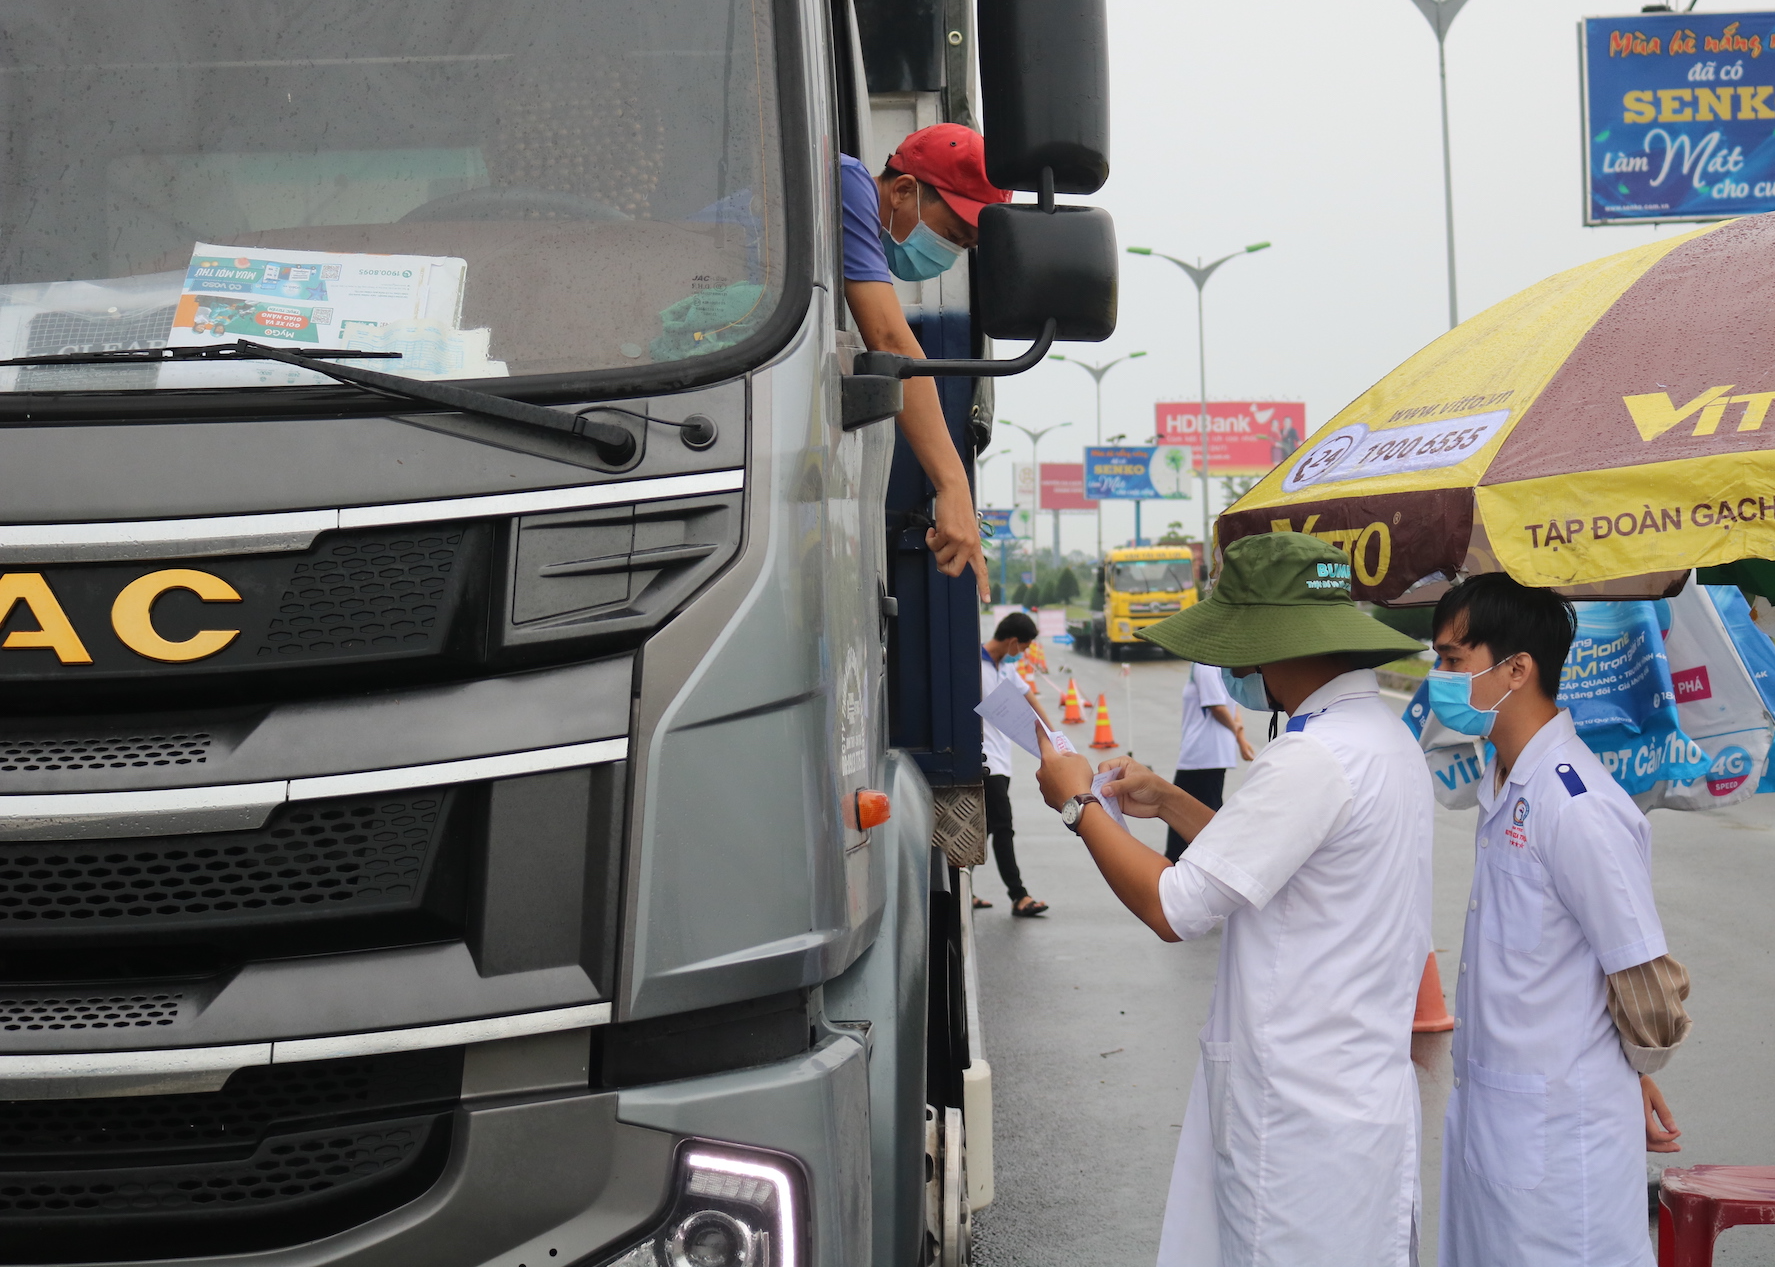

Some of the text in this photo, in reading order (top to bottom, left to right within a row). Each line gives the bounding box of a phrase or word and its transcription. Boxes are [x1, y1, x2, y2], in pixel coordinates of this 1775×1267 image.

[1609, 30, 1661, 57] Mùa
[1704, 21, 1762, 58] nắng
[1688, 60, 1743, 81] đã có
[1623, 85, 1775, 124] SENK
[1603, 128, 1744, 188] Làm Mát
[1711, 178, 1749, 199] cho
[213, 269, 233, 279] MỌI
[235, 271, 257, 280] MUA
[359, 268, 400, 277] 1900.8095
[261, 312, 302, 322] GIAO HÀNG
[1388, 389, 1515, 423] www.vitto.vn
[1094, 464, 1145, 475] SENKO
[1524, 495, 1775, 552] TẬP ĐOÀN GẠCH
[1270, 513, 1391, 587] TTO
[1577, 631, 1630, 662] Home
[1600, 654, 1629, 671] trọn
[1581, 676, 1617, 689] QUANG
[1755, 670, 1769, 679] 4K
[1678, 676, 1704, 694] PHÁ
[1570, 690, 1593, 700] tăng
[1594, 749, 1632, 780] PT
[1710, 752, 1744, 775] 4G
[1715, 781, 1739, 791] SPEED
